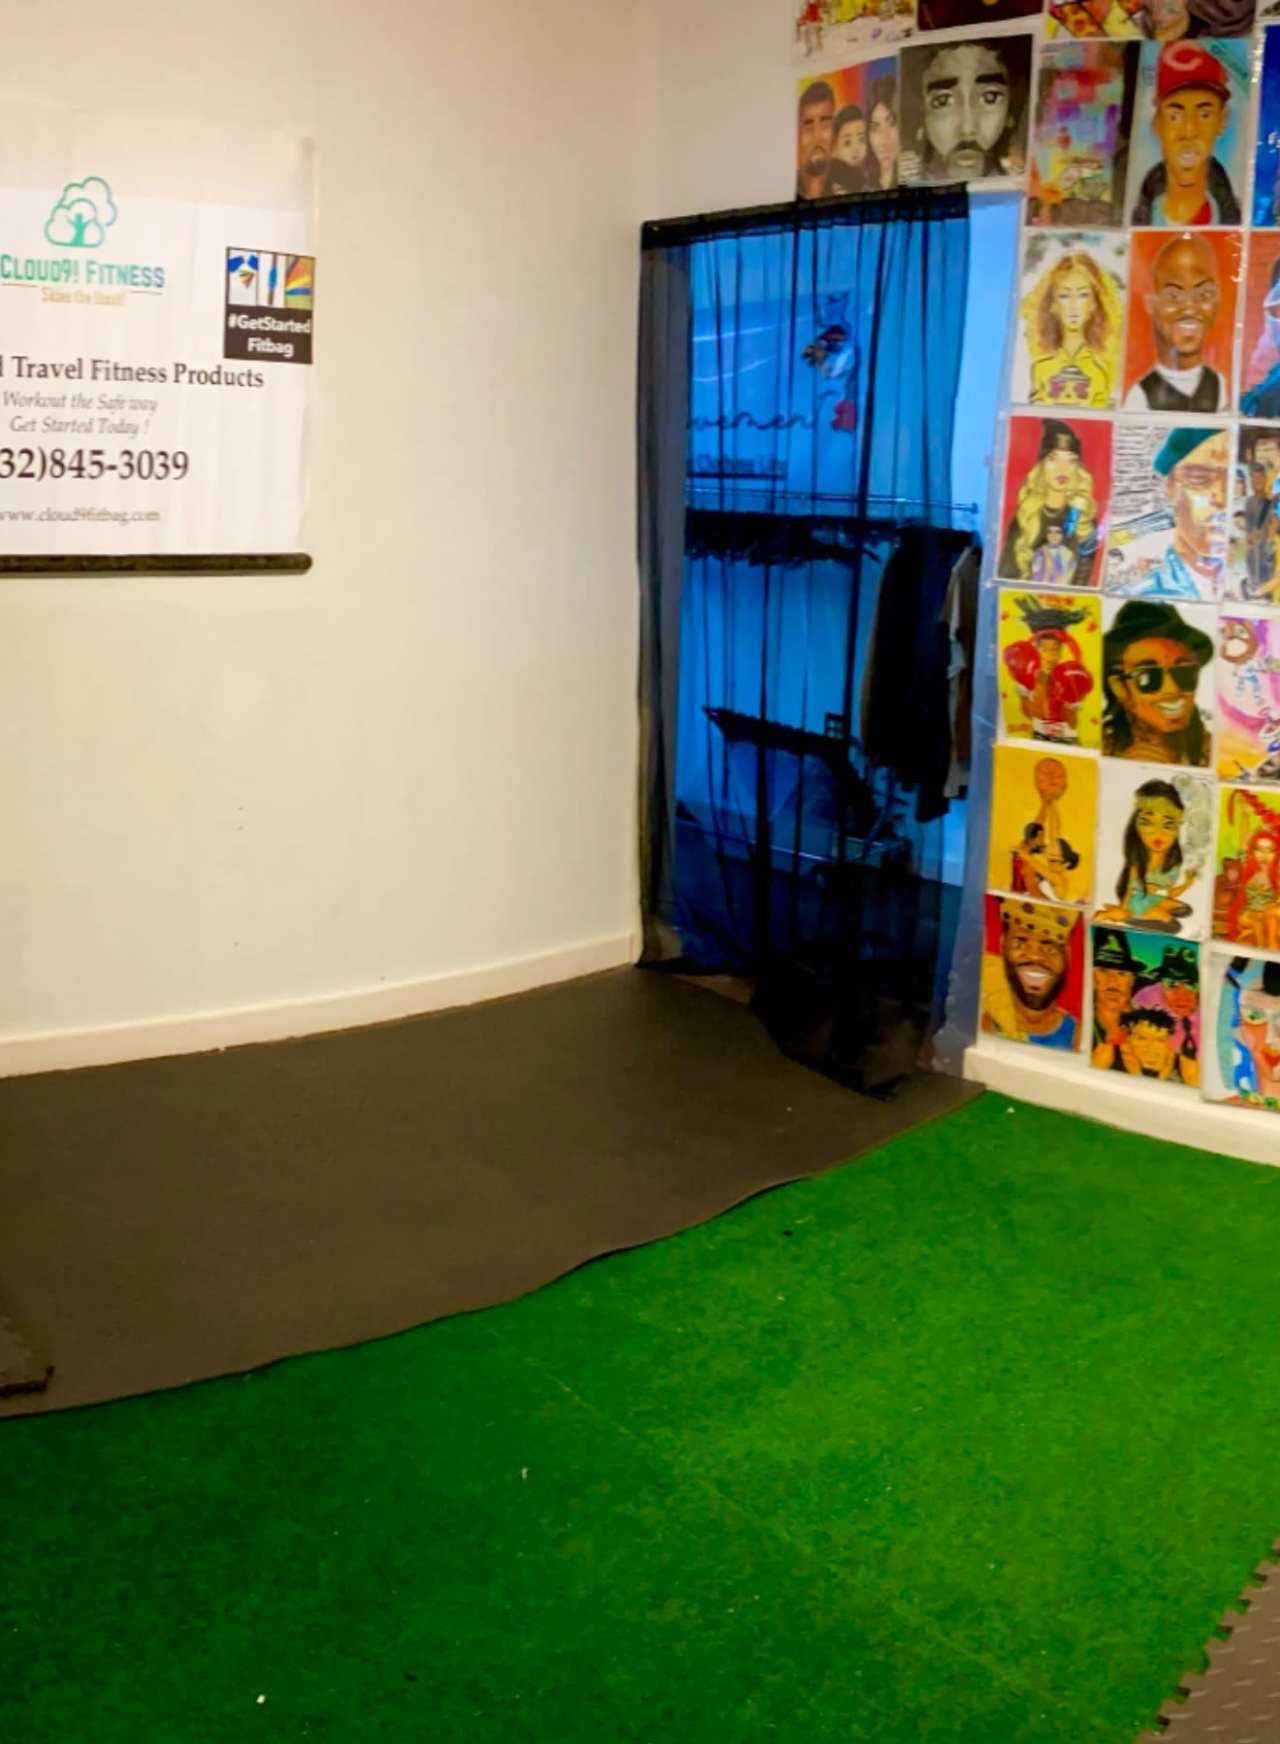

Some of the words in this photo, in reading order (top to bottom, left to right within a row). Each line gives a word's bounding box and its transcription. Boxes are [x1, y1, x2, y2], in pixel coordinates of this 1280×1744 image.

[228, 313, 311, 333] #GetStarted
[246, 336, 294, 358] Fitbag
[10, 356, 83, 380] Travel
[90, 359, 168, 382] Fitness
[173, 363, 264, 387] Products
[3, 390, 67, 408] Workout
[71, 392, 93, 409] the
[96, 393, 124, 413] Safe
[128, 400, 158, 415] way
[9, 416, 36, 433] Get
[40, 417, 93, 434] Started
[98, 419, 139, 438] Today
